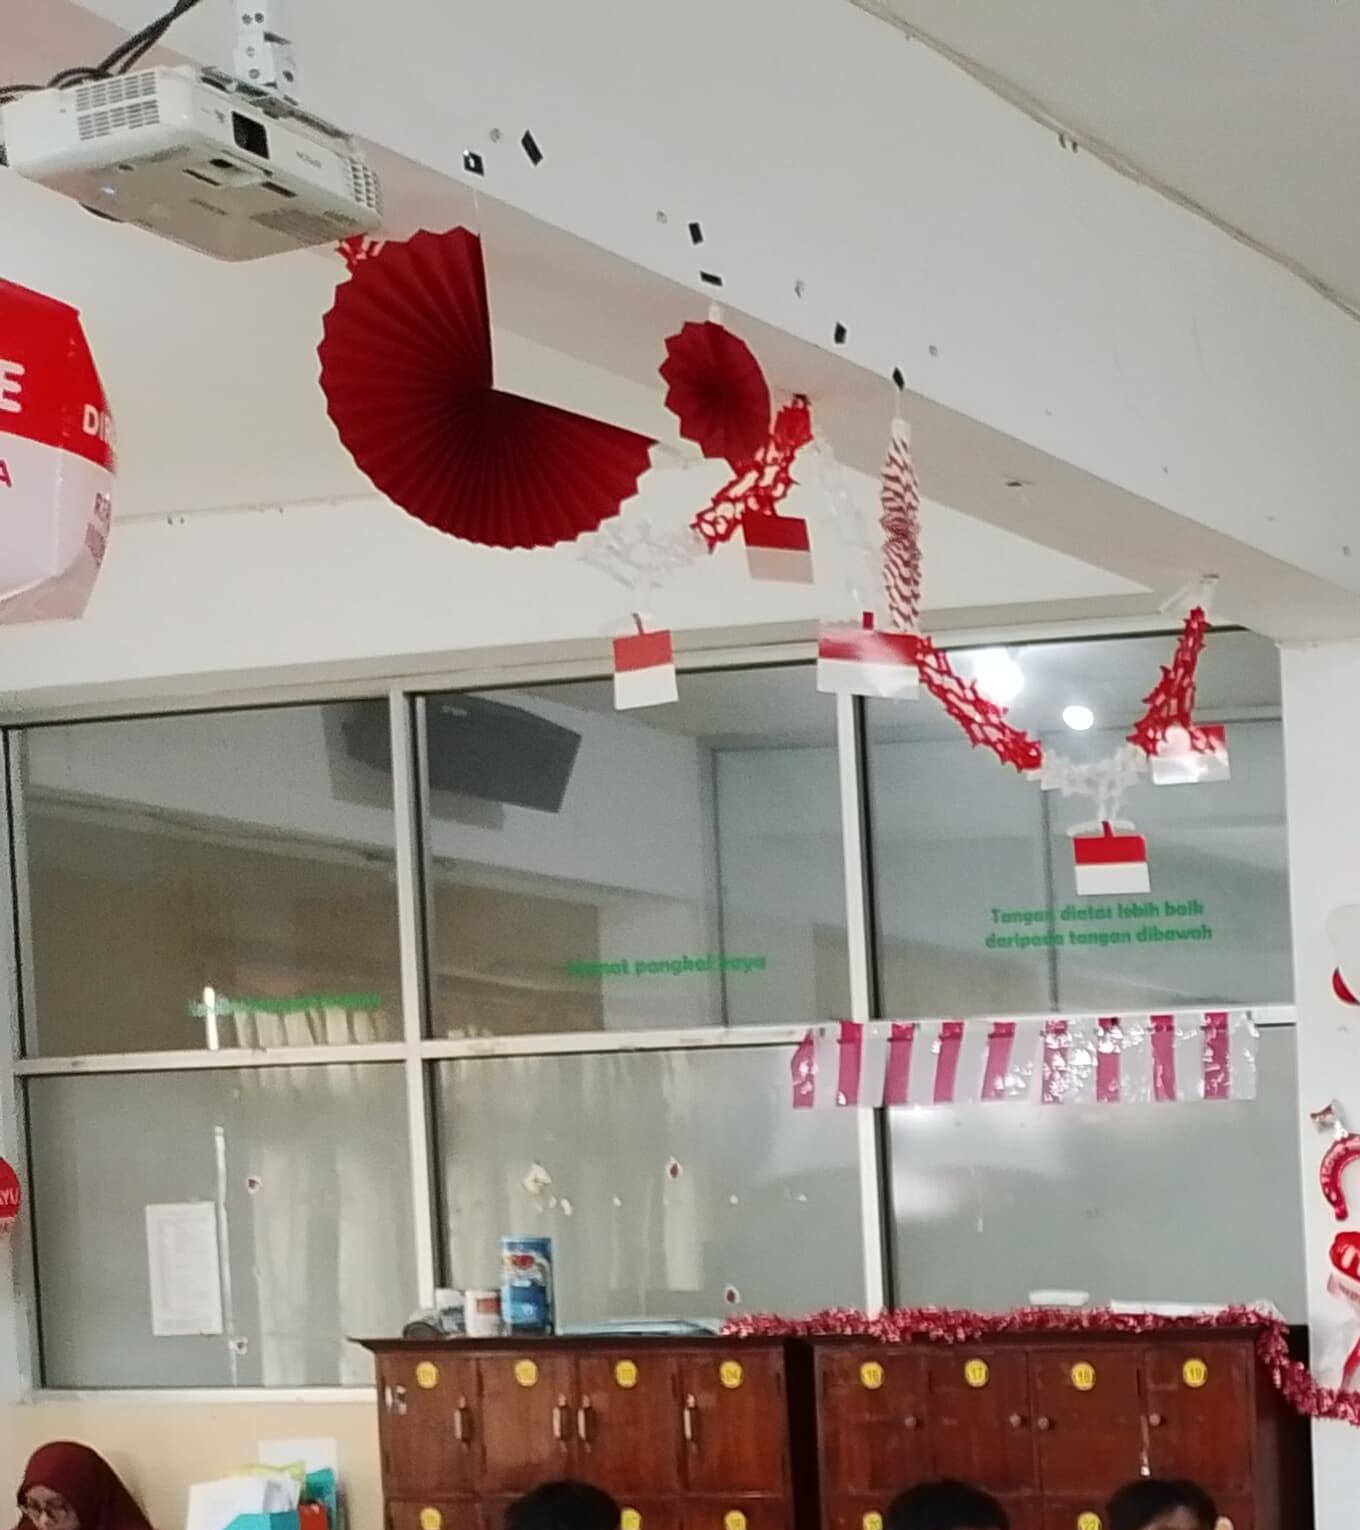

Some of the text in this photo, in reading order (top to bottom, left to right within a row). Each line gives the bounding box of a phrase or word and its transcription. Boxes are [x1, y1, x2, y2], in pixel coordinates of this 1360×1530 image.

[991, 907, 1055, 925] Tangan
[1117, 901, 1160, 919] lebih
[1164, 898, 1205, 918] baik
[985, 924, 1213, 949] daripada tangan dibawah
